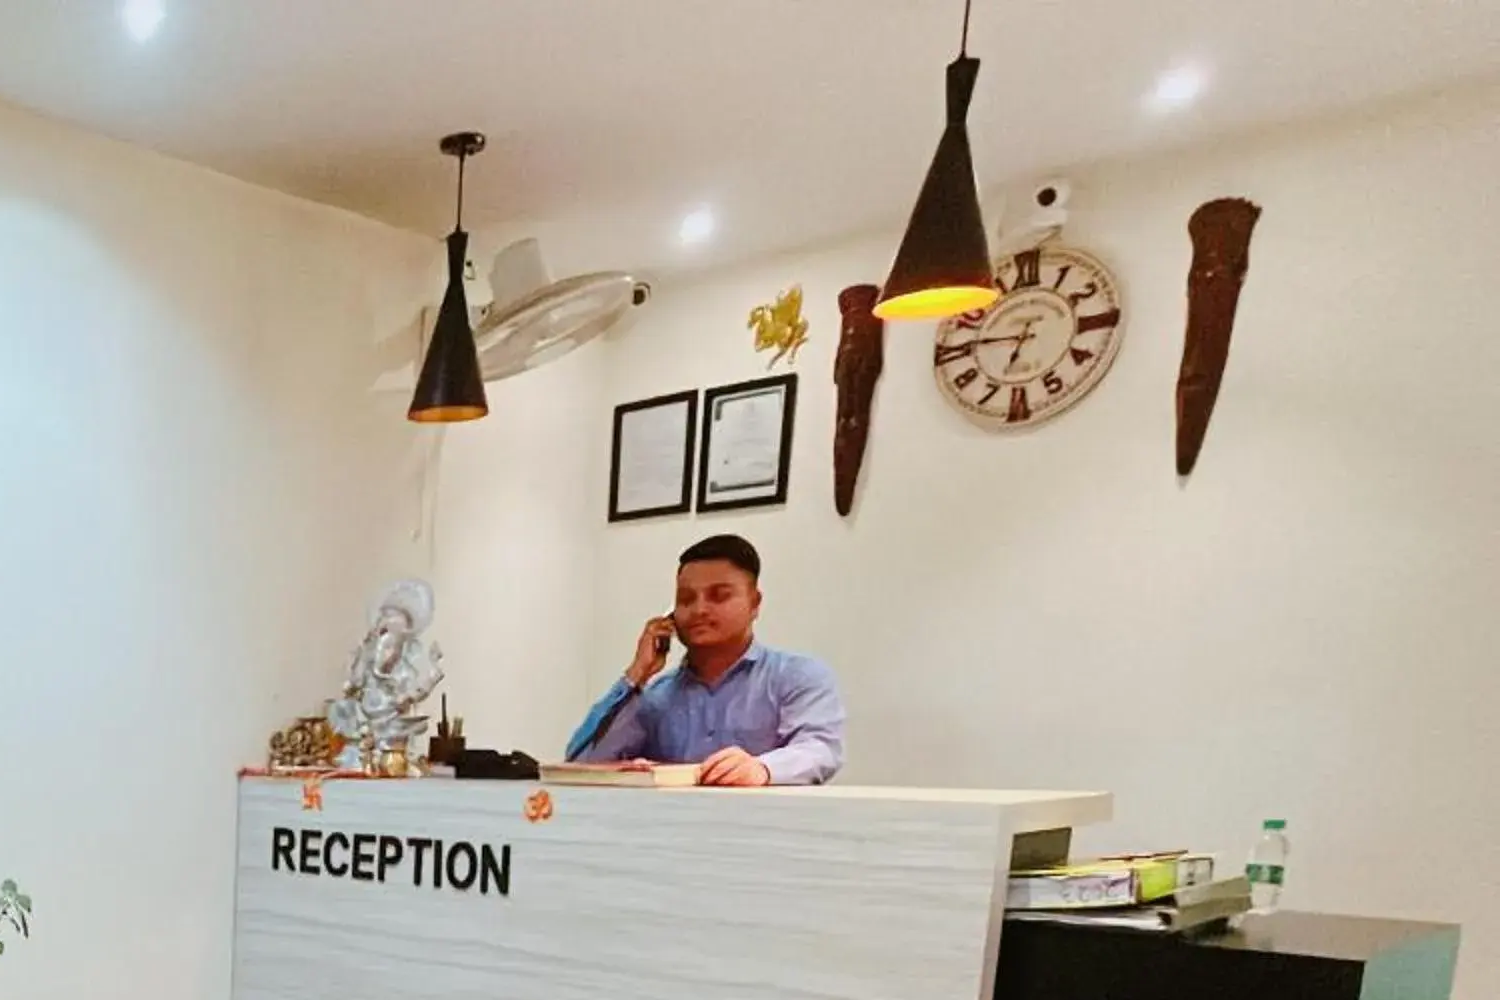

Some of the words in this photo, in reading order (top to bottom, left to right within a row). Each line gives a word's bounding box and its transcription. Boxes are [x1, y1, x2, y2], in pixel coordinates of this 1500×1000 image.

[954, 368, 979, 390] 8
[1042, 370, 1064, 395] 5
[977, 383, 1001, 405] 7
[271, 827, 512, 896] RECEPTION
